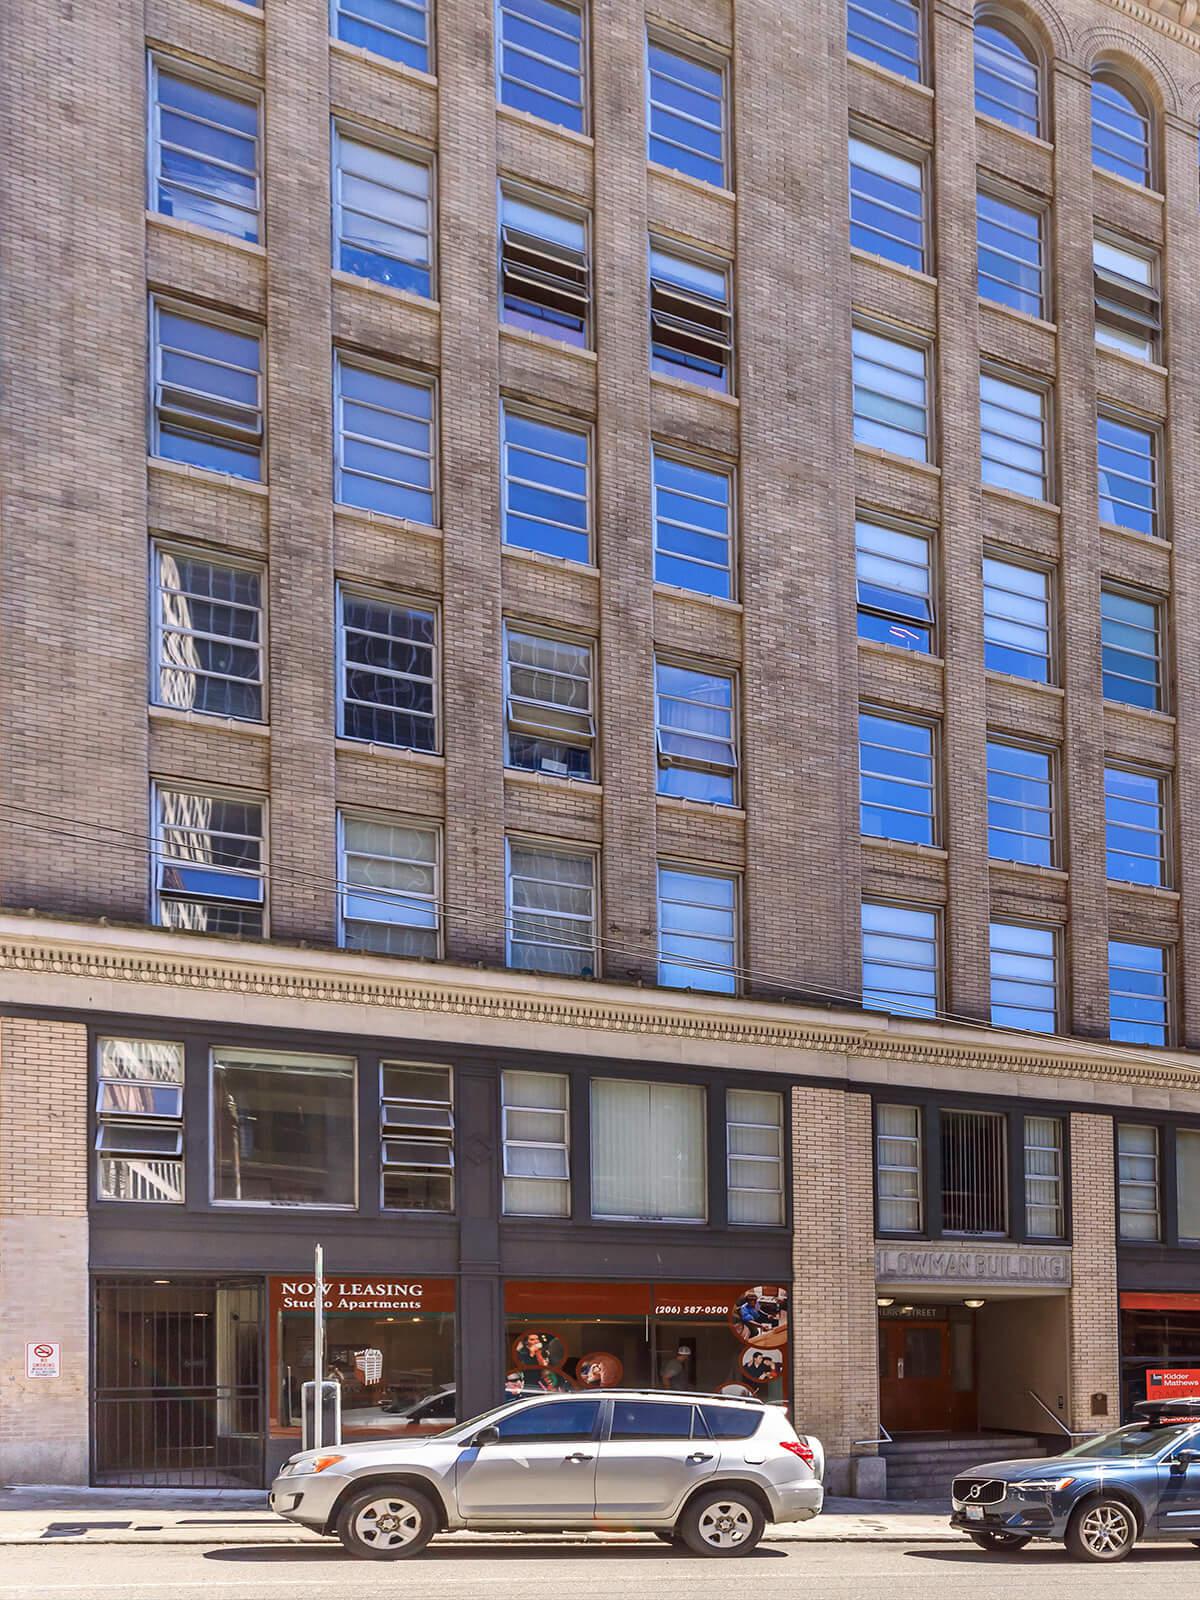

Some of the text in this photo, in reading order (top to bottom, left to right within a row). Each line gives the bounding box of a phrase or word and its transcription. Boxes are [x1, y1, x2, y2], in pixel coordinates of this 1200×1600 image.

[883, 1251, 1064, 1277] LOWMAN BUILDING
[281, 1282, 424, 1296] NOW LEASING
[283, 1297, 421, 1311] Studo Apartments
[655, 1306, 729, 1314] (206) 587-0500
